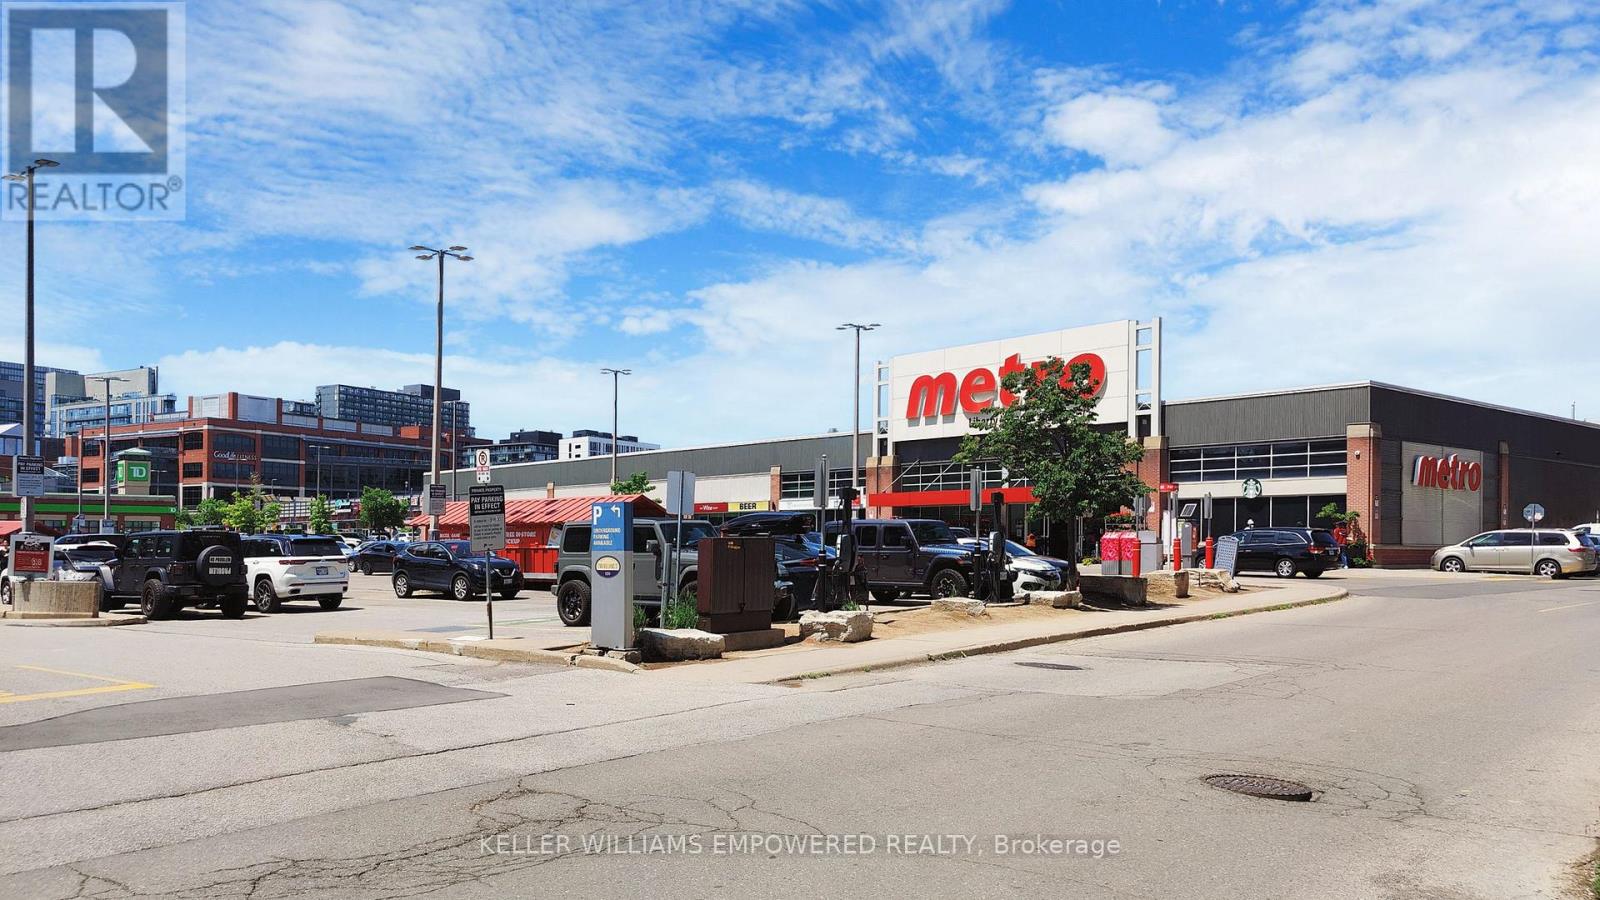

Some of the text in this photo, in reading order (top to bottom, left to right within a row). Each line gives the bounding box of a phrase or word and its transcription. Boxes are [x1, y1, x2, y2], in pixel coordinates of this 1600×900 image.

[130, 466, 146, 478] TD
[1416, 453, 1481, 492] metro
[481, 495, 503, 503] PARKING
[481, 502, 501, 510] EFFECT
[739, 502, 757, 510] BEER
[593, 505, 602, 525] P
